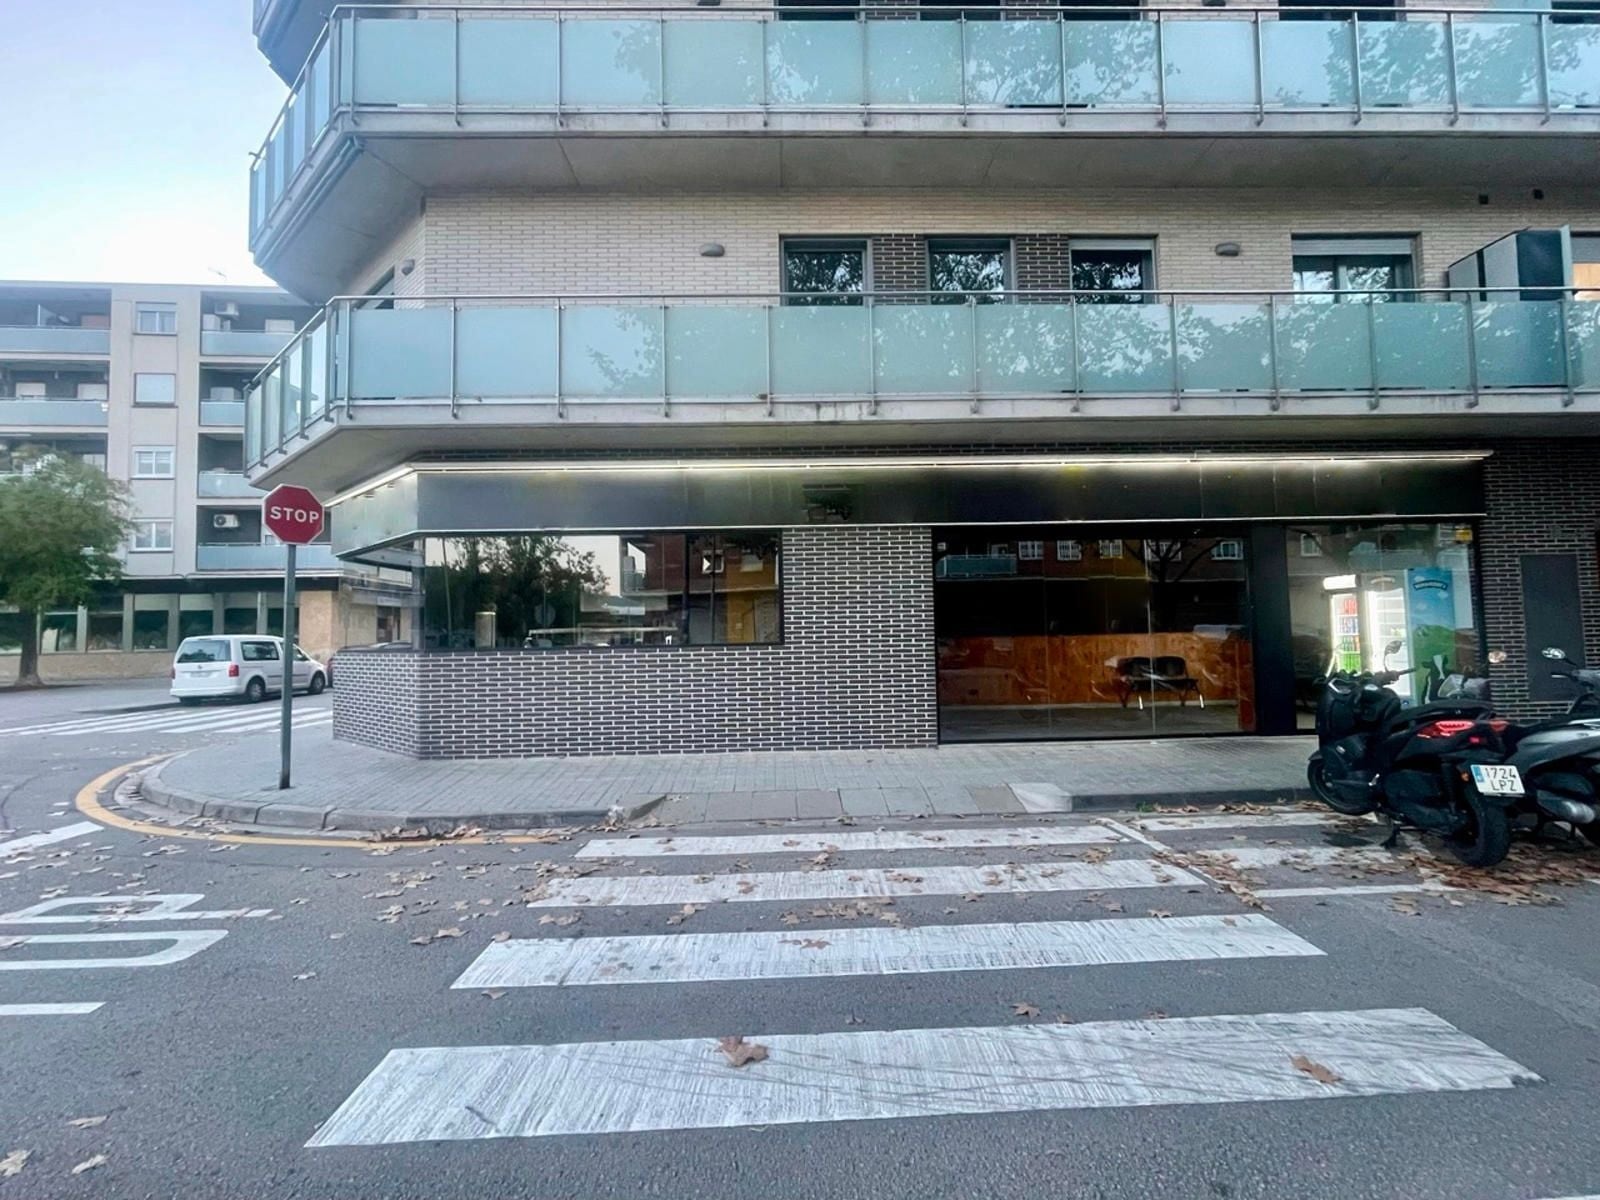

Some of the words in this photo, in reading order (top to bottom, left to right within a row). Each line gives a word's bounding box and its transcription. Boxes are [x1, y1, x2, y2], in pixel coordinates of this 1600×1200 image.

[270, 505, 320, 524] STOP
[1485, 767, 1517, 780] 1724
[1491, 779, 1518, 792] LPZ
